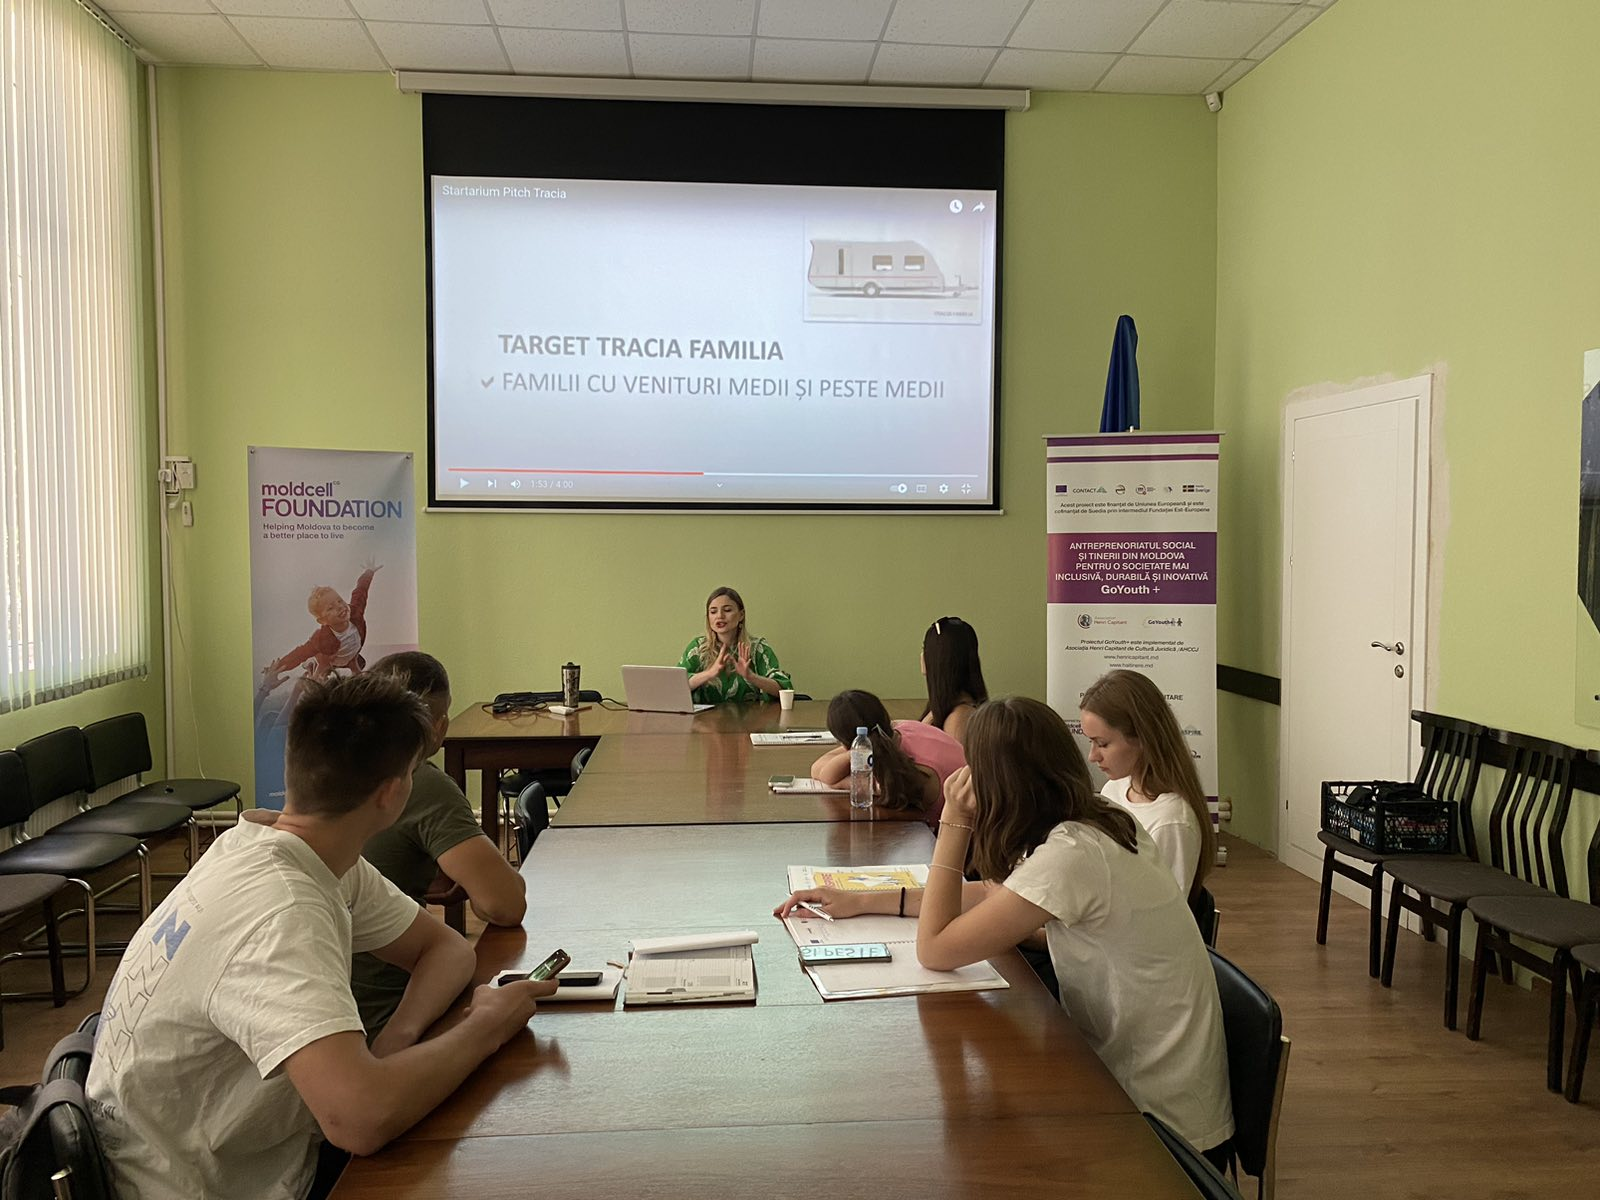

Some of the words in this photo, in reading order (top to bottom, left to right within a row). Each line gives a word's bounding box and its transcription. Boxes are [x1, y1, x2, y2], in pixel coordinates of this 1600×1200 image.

[442, 185, 500, 197] Startarium
[503, 187, 531, 198] Pitch
[534, 188, 567, 199] Tracia
[498, 334, 590, 356] TARGET
[596, 337, 682, 358] TRACIA
[690, 339, 784, 360] FAMILIA
[503, 373, 579, 393] FAMILII
[587, 374, 616, 393] CU
[623, 375, 721, 396] VENITURI
[729, 377, 788, 397] MEDII
[820, 379, 878, 398] PESTE
[886, 380, 944, 399] MEDII
[262, 481, 333, 497] moldcell
[530, 479, 548, 489] 1:53
[262, 498, 402, 518] FOUNDATION
[263, 523, 295, 532] Helping
[297, 532, 319, 541] place
[1069, 542, 1161, 550] ANTREPRENORIATUL
[1162, 541, 1196, 549] SOCIAL
[1089, 552, 1120, 560] TINERII
[1076, 562, 1111, 570] PENTRU
[1122, 562, 1171, 570] SOCIETATE
[1172, 562, 1189, 570] MAI
[1101, 585, 1150, 595] GoYouth
